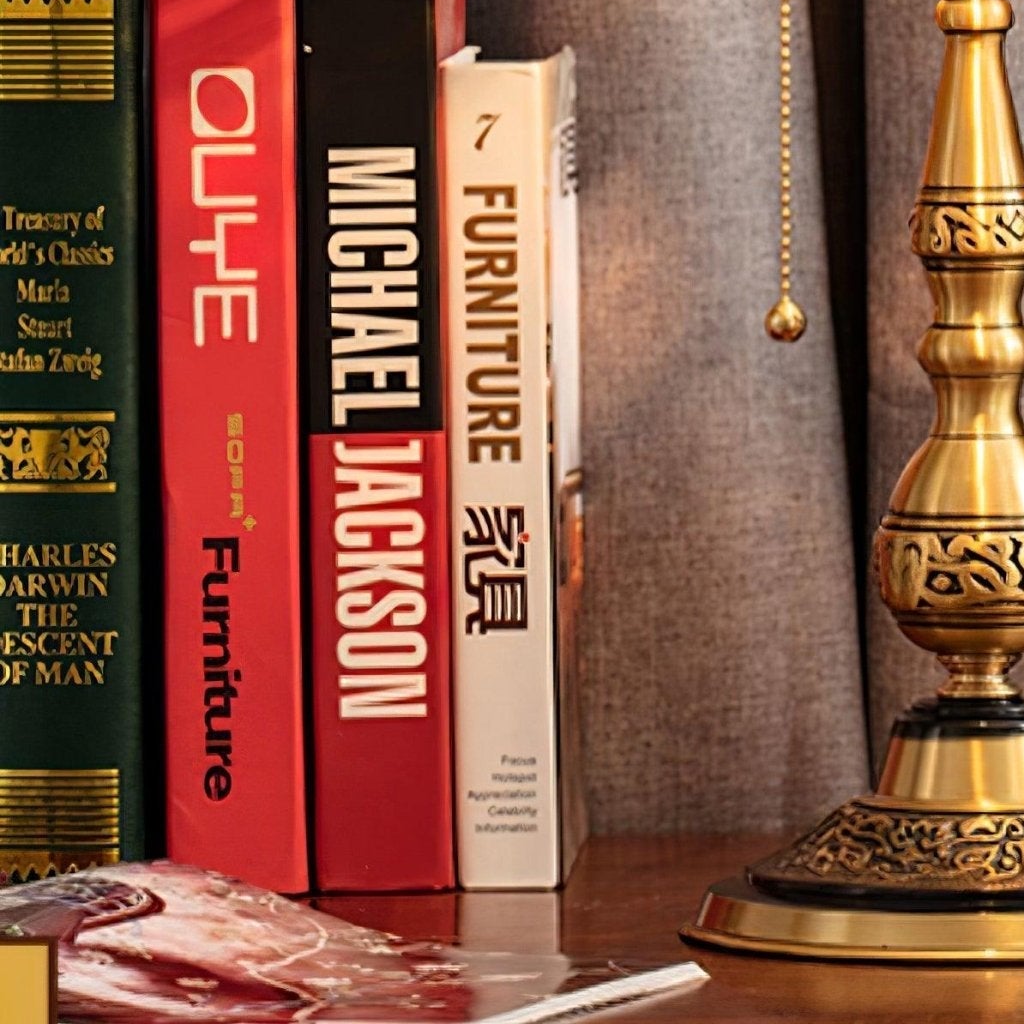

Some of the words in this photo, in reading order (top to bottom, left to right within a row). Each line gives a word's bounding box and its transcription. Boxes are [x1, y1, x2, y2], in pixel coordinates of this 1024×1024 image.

[474, 113, 500, 151] 7
[328, 147, 421, 428] MICHAEL
[463, 185, 523, 465] FURNITURE
[16, 603, 78, 627] THE
[35, 661, 105, 686] MAN
[202, 537, 242, 803] Furniture
[334, 439, 429, 721] JACKSON
